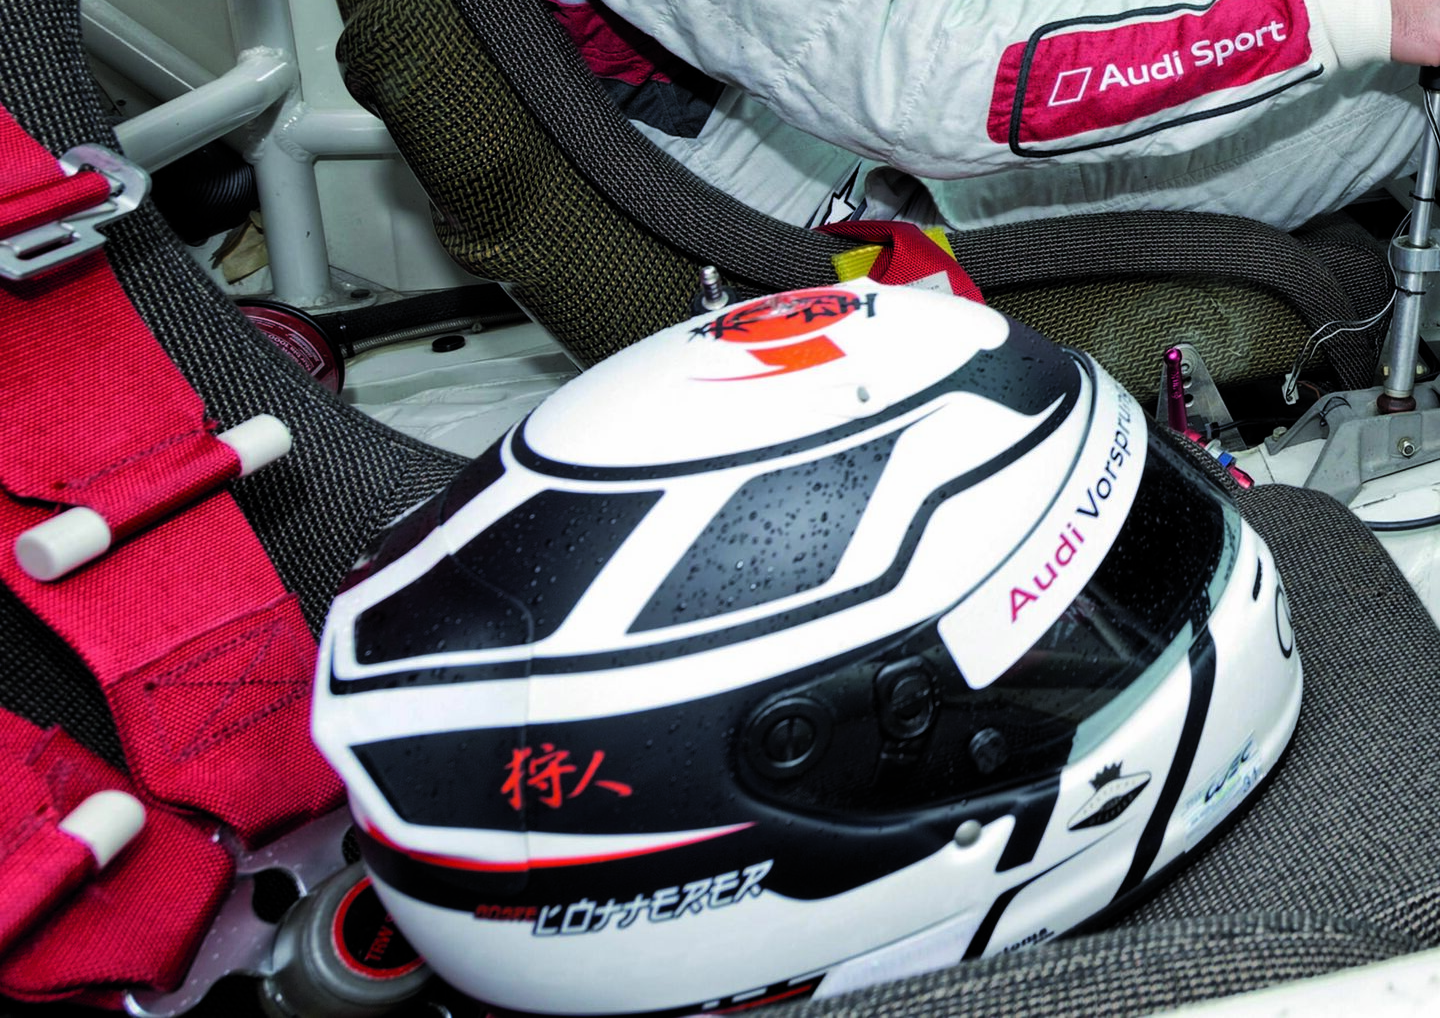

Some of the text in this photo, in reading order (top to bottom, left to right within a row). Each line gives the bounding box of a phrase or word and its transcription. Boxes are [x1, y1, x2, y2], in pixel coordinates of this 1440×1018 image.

[1099, 20, 1287, 91] Audi Sport
[1011, 522, 1085, 623] Audi
[500, 743, 633, 811] 狩人
[364, 925, 394, 962] TRW
